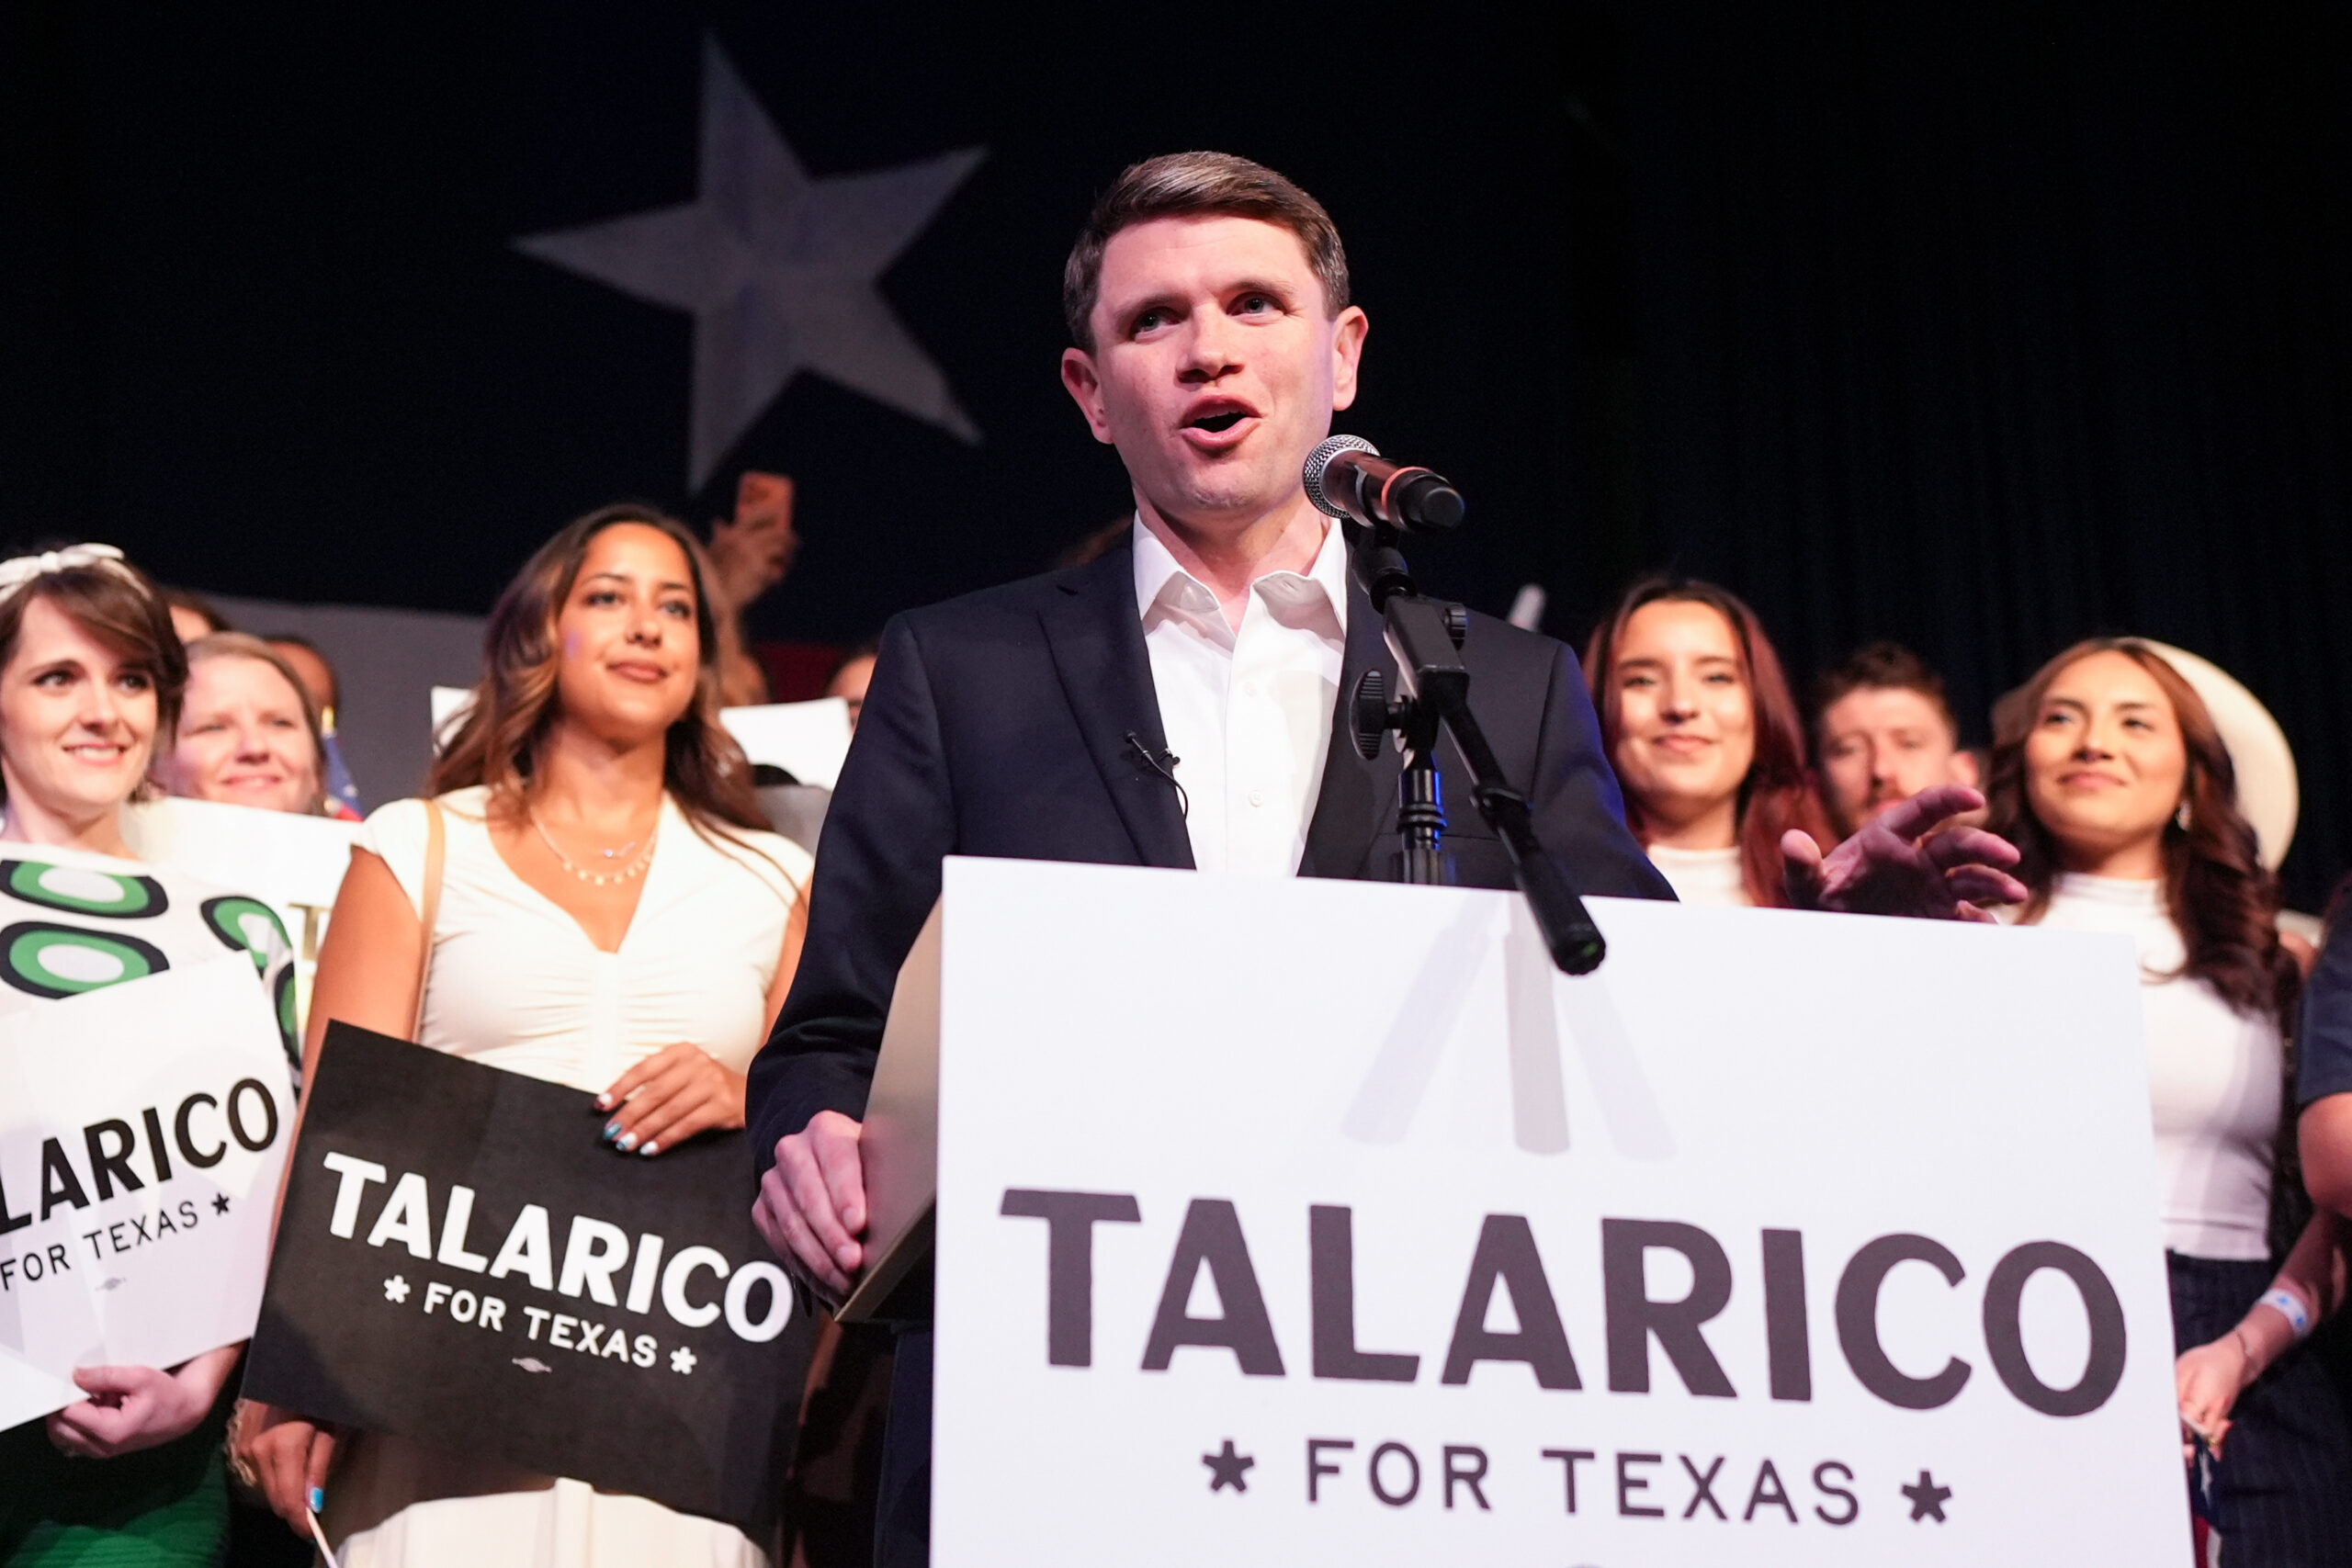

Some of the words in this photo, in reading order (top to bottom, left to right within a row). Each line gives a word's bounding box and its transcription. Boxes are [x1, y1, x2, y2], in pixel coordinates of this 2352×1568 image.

[0, 1243, 71, 1292] FOR
[83, 1201, 198, 1259] TEXAS
[322, 1151, 793, 1343] TALARICO
[424, 1281, 506, 1332] FOR
[523, 1306, 658, 1369] TEXAS
[1000, 1188, 2128, 1419] TALARICO
[1306, 1438, 1491, 1510] FOR
[1541, 1449, 1860, 1527] TEXAS
